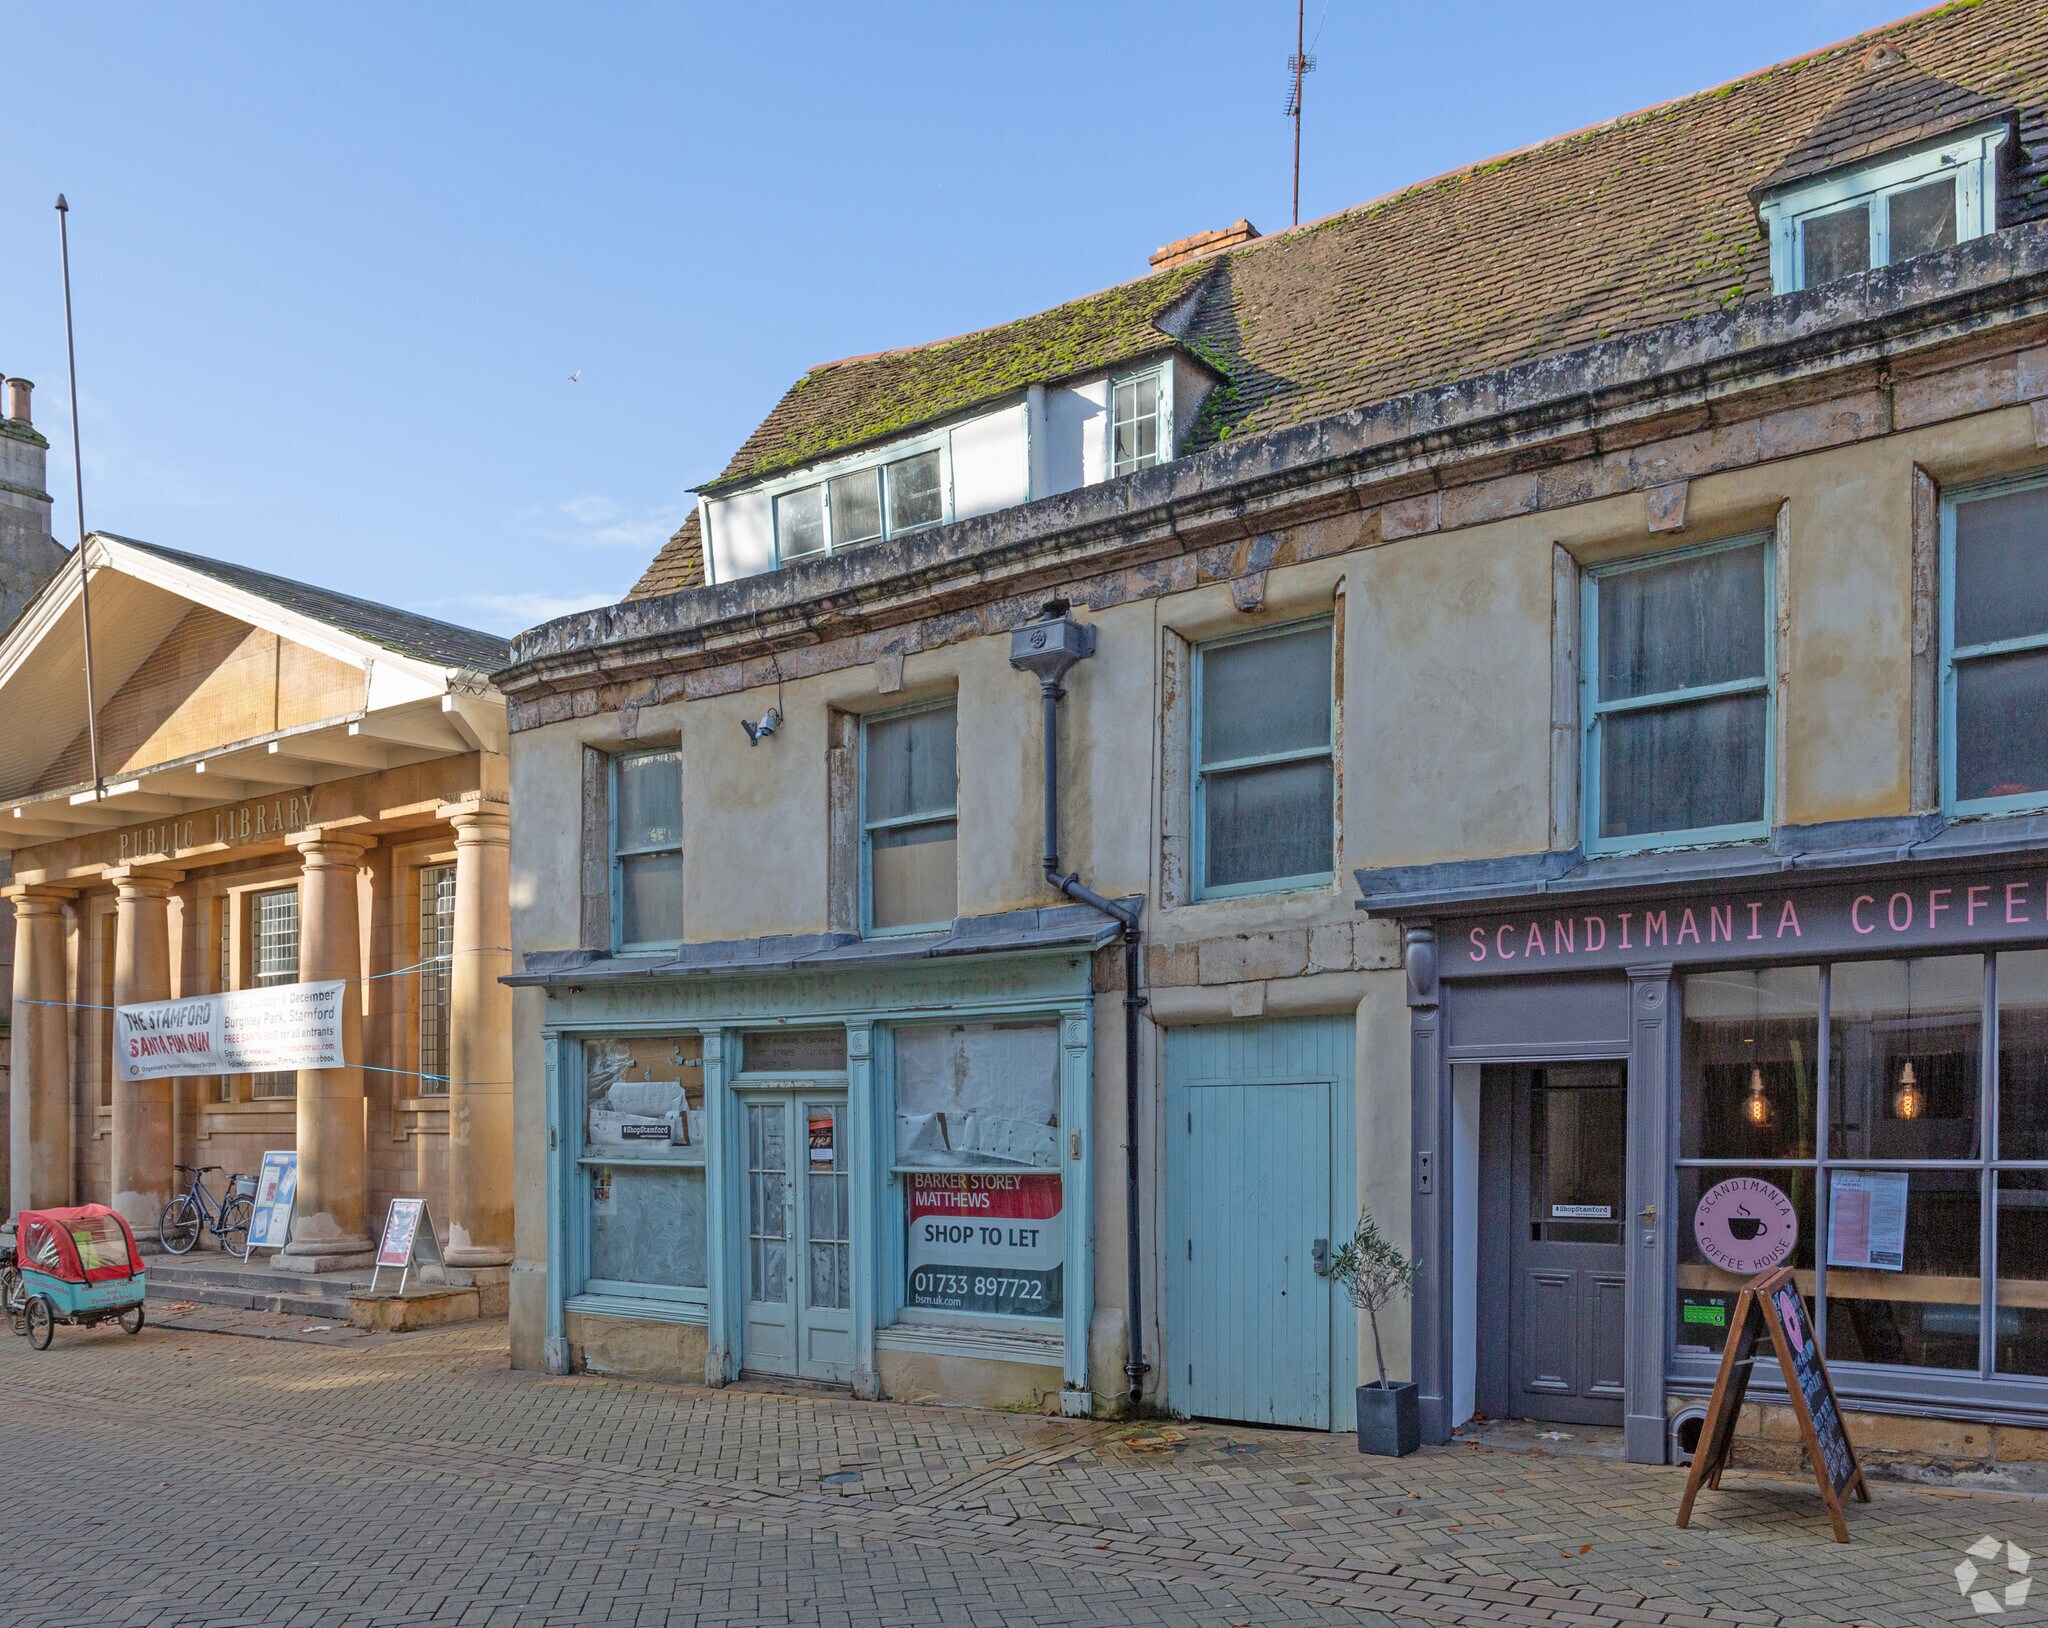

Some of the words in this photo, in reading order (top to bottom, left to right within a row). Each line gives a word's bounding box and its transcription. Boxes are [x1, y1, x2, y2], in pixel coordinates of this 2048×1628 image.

[119, 819, 195, 861] PUBLIC
[214, 793, 315, 843] LIBRARY
[1468, 900, 1802, 962] SCANDIMANIA
[1851, 881, 2048, 934] COFFE
[289, 989, 336, 1004] December
[124, 1011, 149, 1031] THE
[148, 1002, 212, 1030] STAMFORD
[289, 1006, 335, 1023] Stamford
[129, 1034, 170, 1057] SANTA
[166, 1032, 189, 1054] FUN
[187, 1031, 211, 1053] RUN
[224, 1033, 240, 1044] FREE
[301, 1026, 334, 1038] entrants
[307, 1053, 335, 1064] facebook
[623, 1125, 669, 1135] #ShopStamford
[915, 1173, 966, 1189] BARKER
[970, 1174, 1022, 1190] STOREY
[915, 1191, 990, 1208] MATTHEWS
[1700, 1180, 1791, 1216] SCANDIMANIA
[1555, 1205, 1608, 1213] #ShopStamford
[924, 1224, 974, 1244] SHOP
[979, 1227, 1002, 1246] TO
[1008, 1228, 1040, 1248] LET
[1701, 1236, 1745, 1270] COFFEE
[1753, 1238, 1791, 1269] HOUSE
[915, 1272, 968, 1294] 01733
[974, 1276, 1042, 1300] 897722
[915, 1293, 961, 1306] bsm.uk.com
